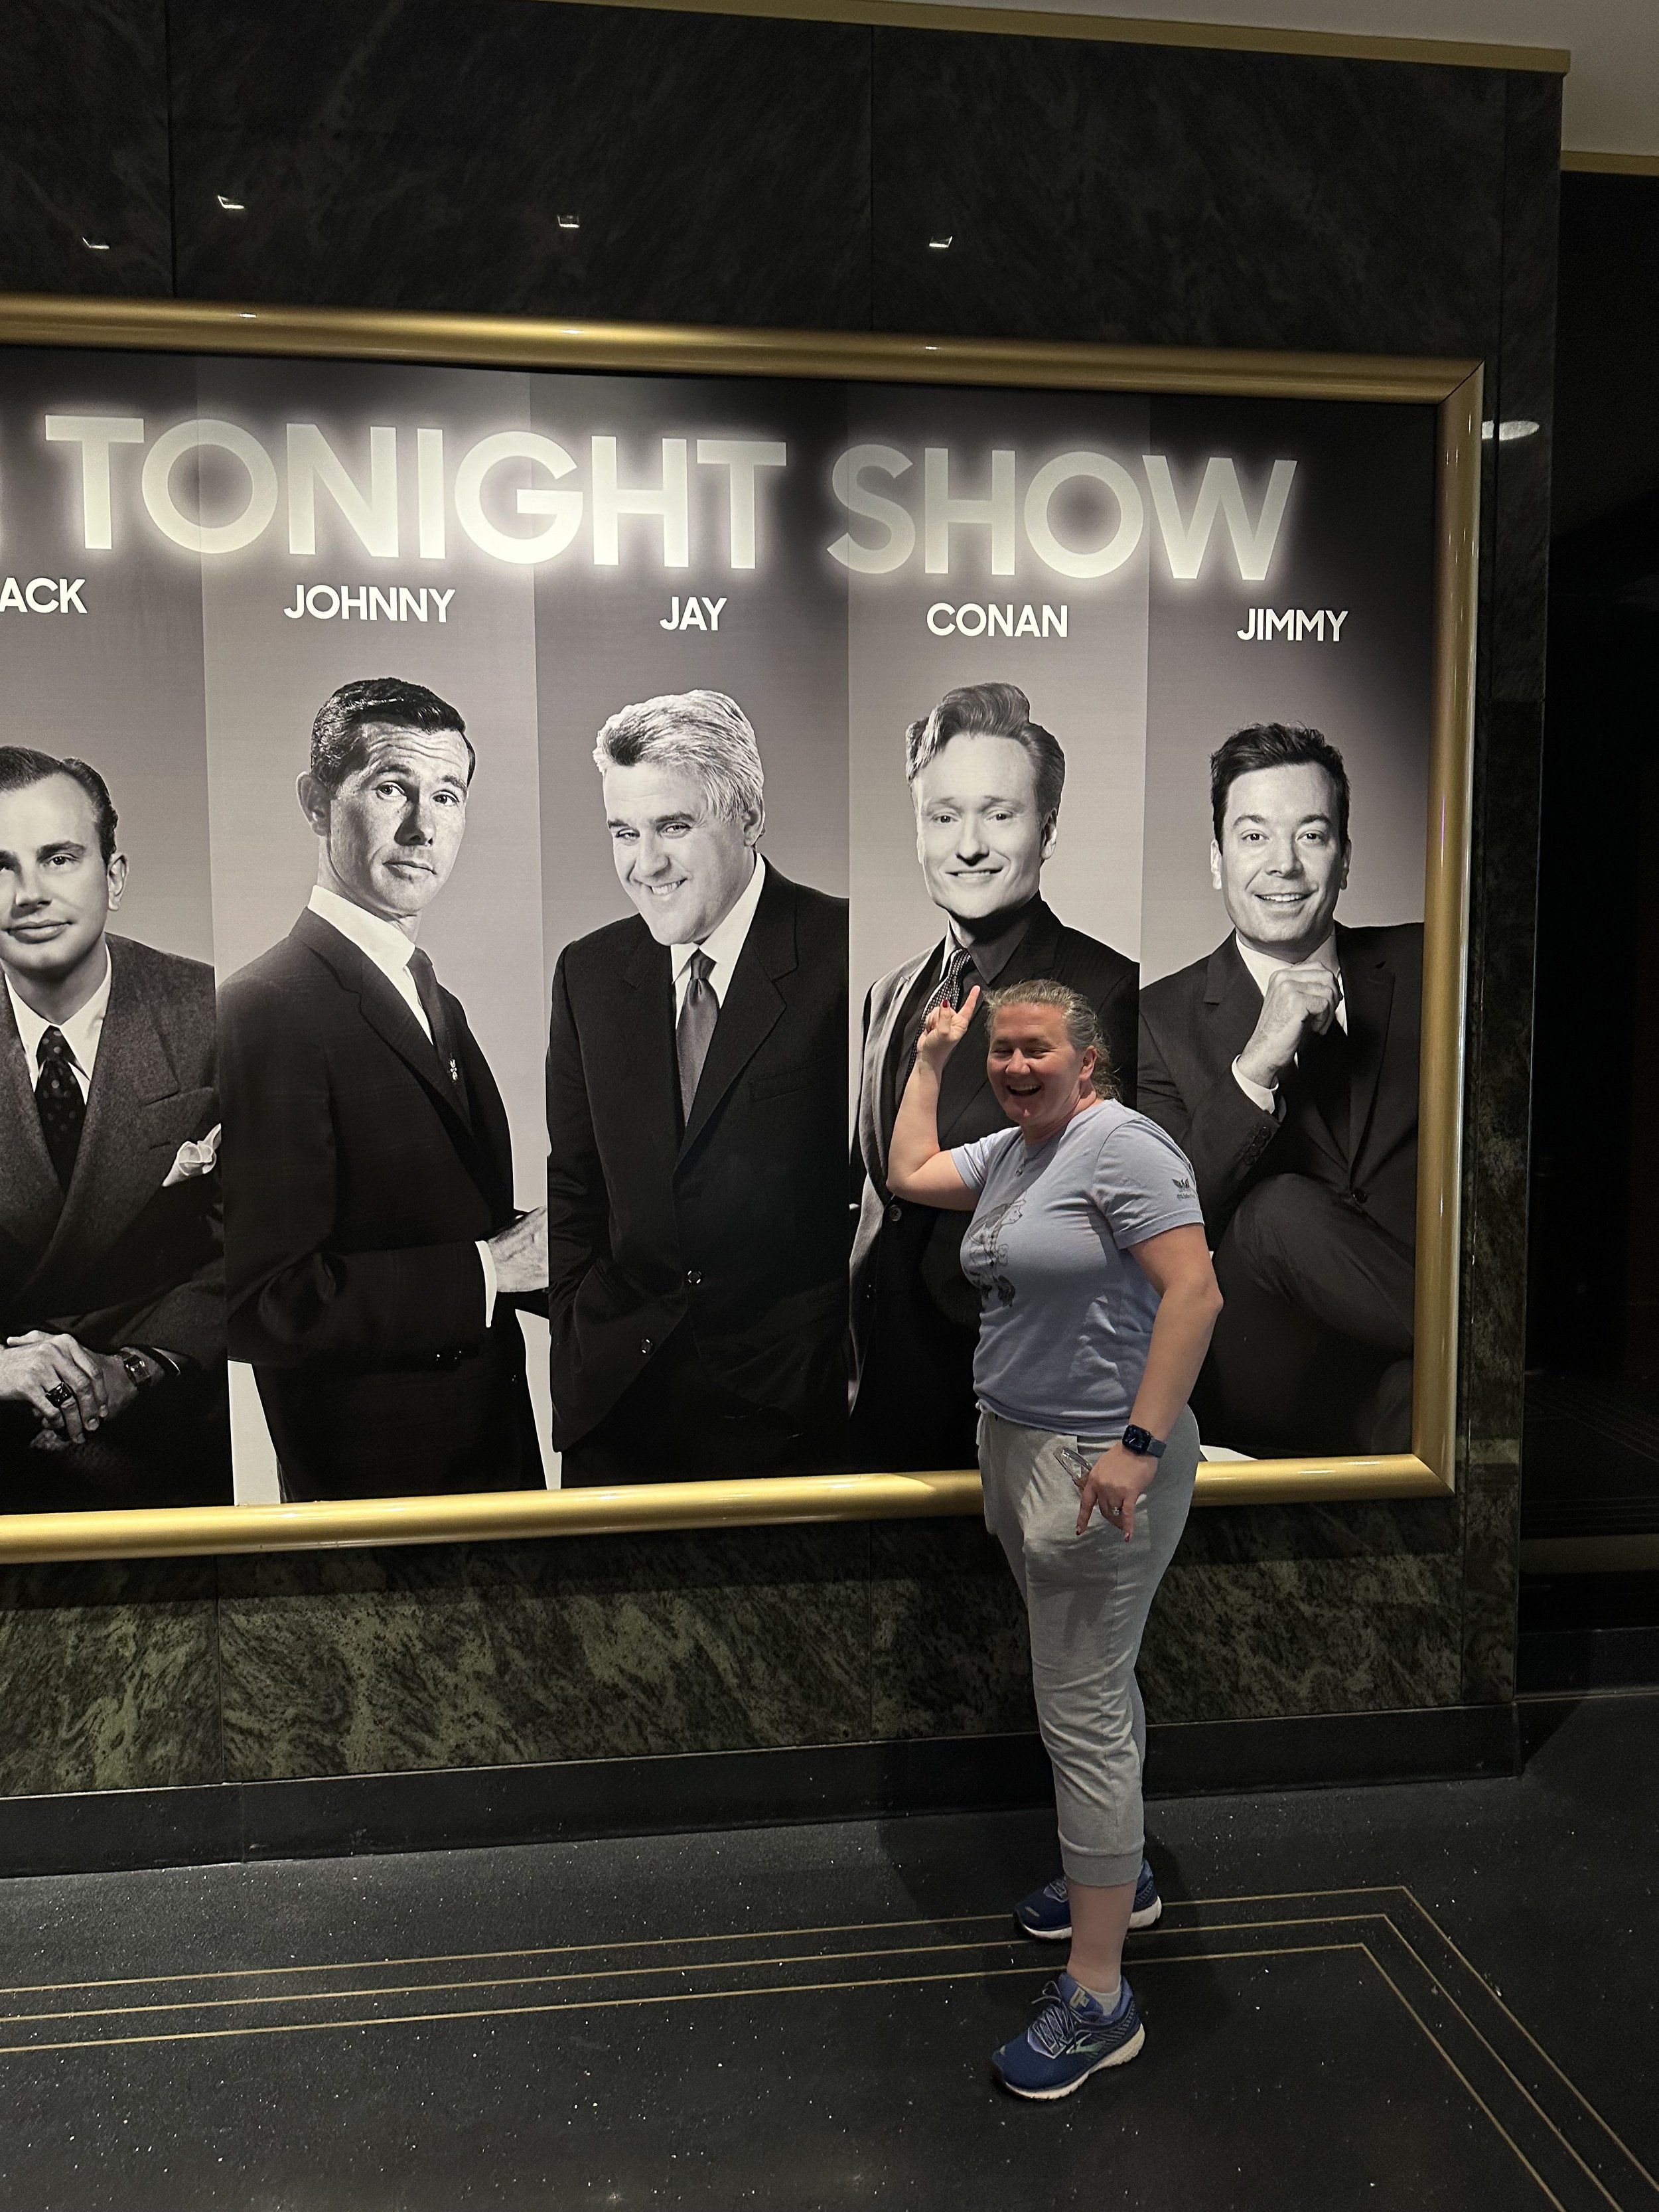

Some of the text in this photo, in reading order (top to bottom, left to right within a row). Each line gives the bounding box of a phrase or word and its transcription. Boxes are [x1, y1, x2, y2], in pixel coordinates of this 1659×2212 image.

[45, 415, 1297, 581] TONIGHT SHOW
[0, 577, 88, 614] ACK
[283, 584, 456, 623] JOHNNY
[660, 596, 727, 631] JAY
[926, 603, 1068, 638] CONAN
[1236, 608, 1348, 642] JIMMY
